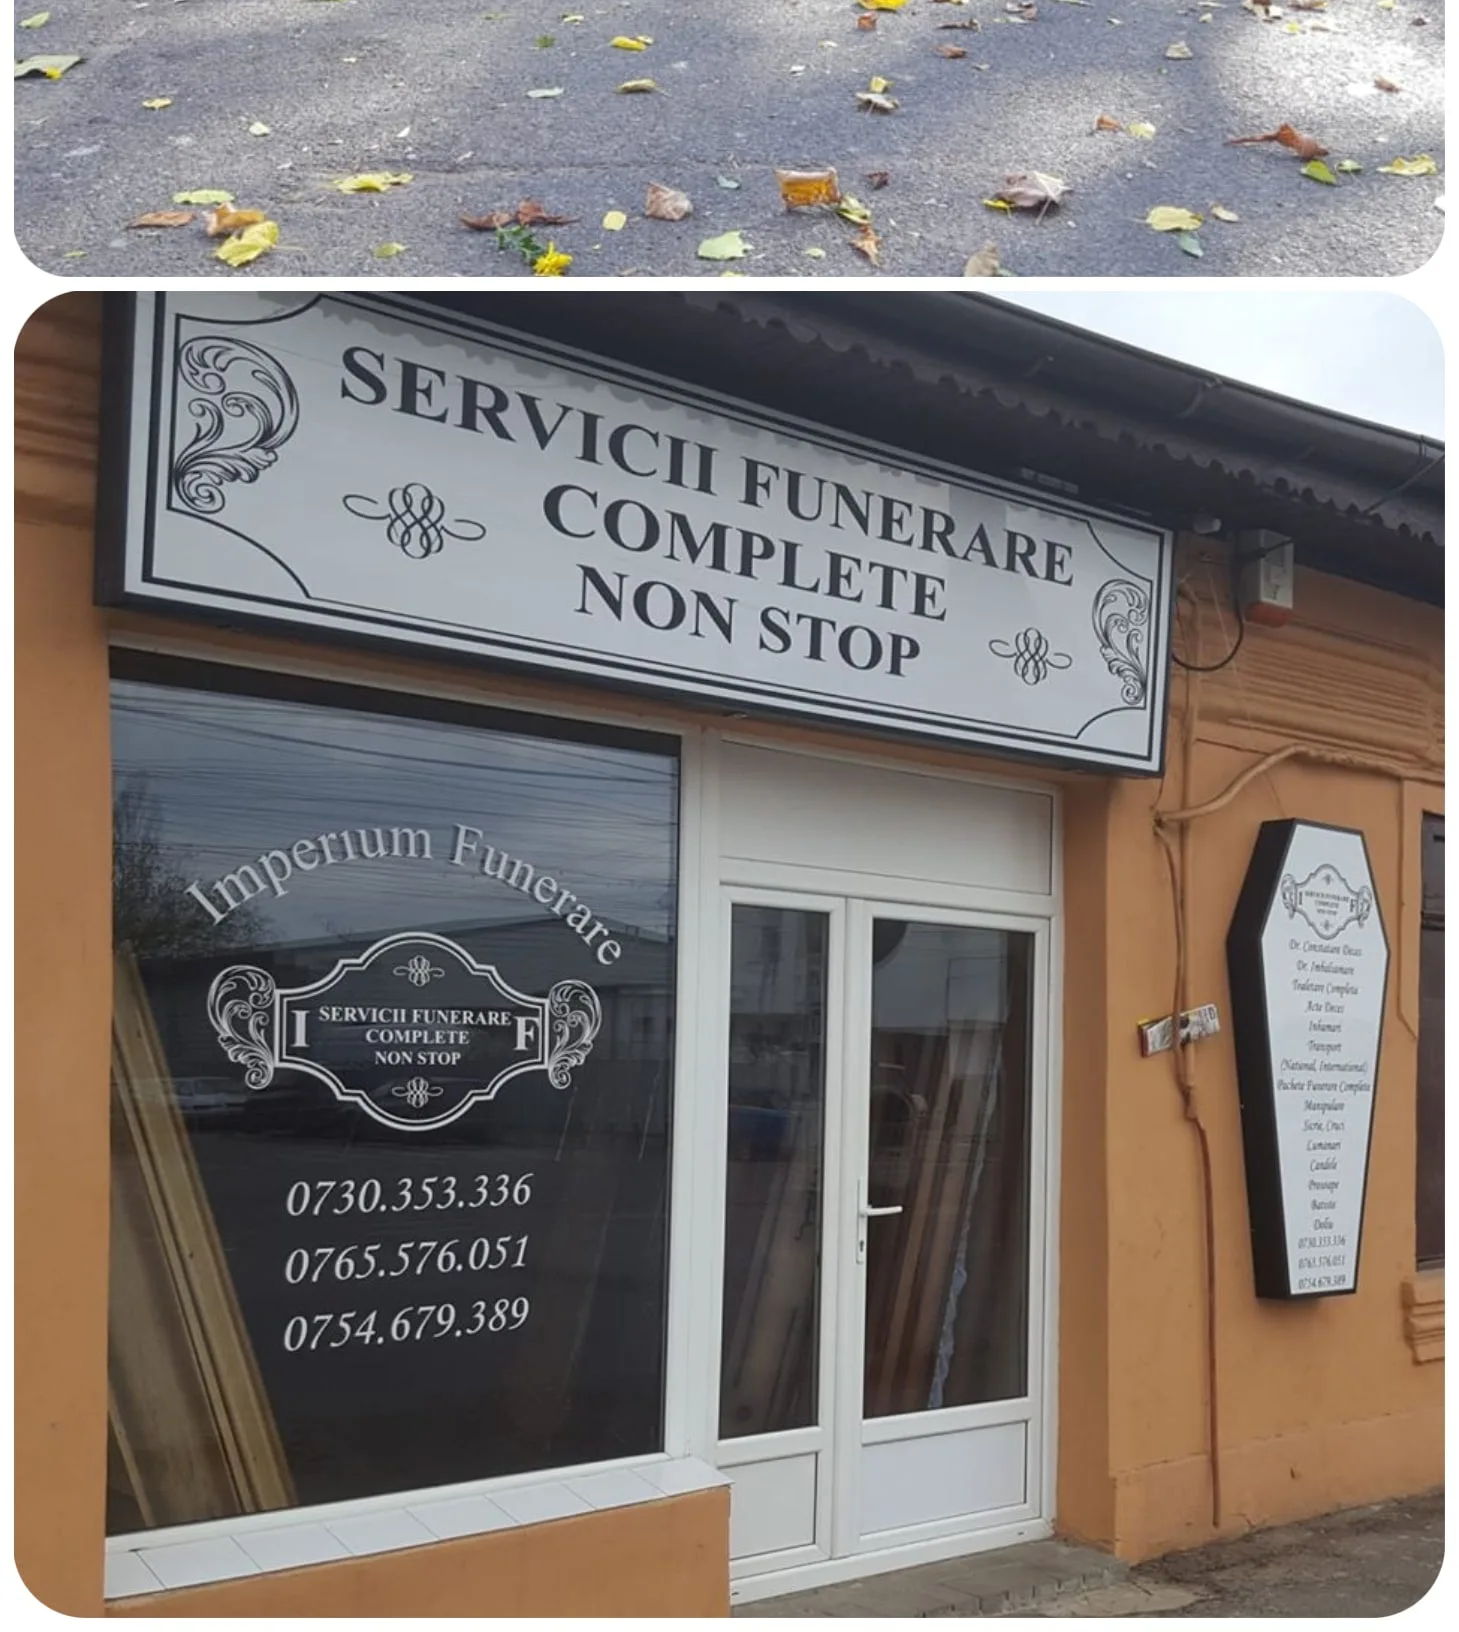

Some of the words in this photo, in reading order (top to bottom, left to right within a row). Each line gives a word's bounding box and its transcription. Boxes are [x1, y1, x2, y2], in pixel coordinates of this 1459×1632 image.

[340, 346, 718, 496] SERVICII
[741, 456, 1073, 587] FUNERARE
[543, 484, 947, 621] COMPLETE
[575, 565, 737, 644] NON
[759, 606, 920, 677] STOP
[186, 825, 433, 925] Imperium
[451, 824, 622, 966] Funerare
[319, 1006, 406, 1024] SERVICII
[412, 1008, 512, 1026] FUNERARE
[366, 1028, 470, 1045] COMPLETE
[513, 1016, 541, 1050] F
[375, 1051, 413, 1065] NON
[418, 1052, 461, 1065] STOP
[286, 1173, 534, 1216] 0730.353.336
[285, 1235, 530, 1284] 0765.576.051
[284, 1297, 530, 1351] 0754.679.389
